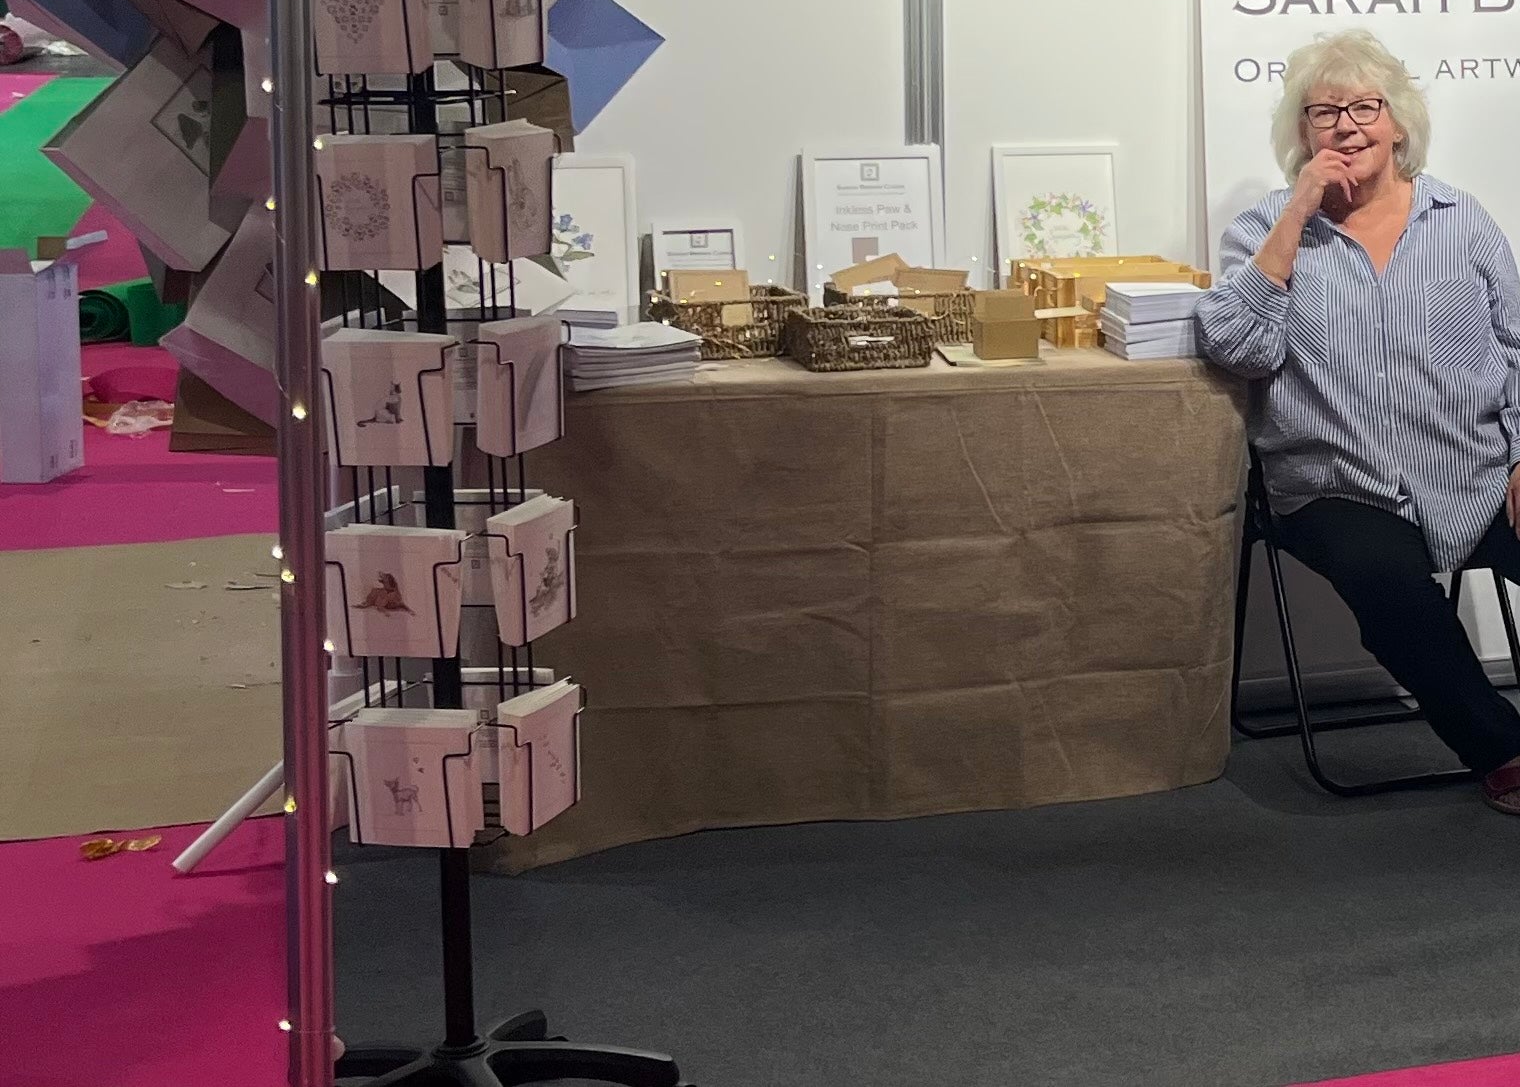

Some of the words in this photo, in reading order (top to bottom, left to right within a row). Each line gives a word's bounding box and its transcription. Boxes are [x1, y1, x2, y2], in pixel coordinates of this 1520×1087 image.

[835, 205, 873, 215] Inkless
[877, 204, 900, 214] Paw
[891, 220, 918, 231] Pack
